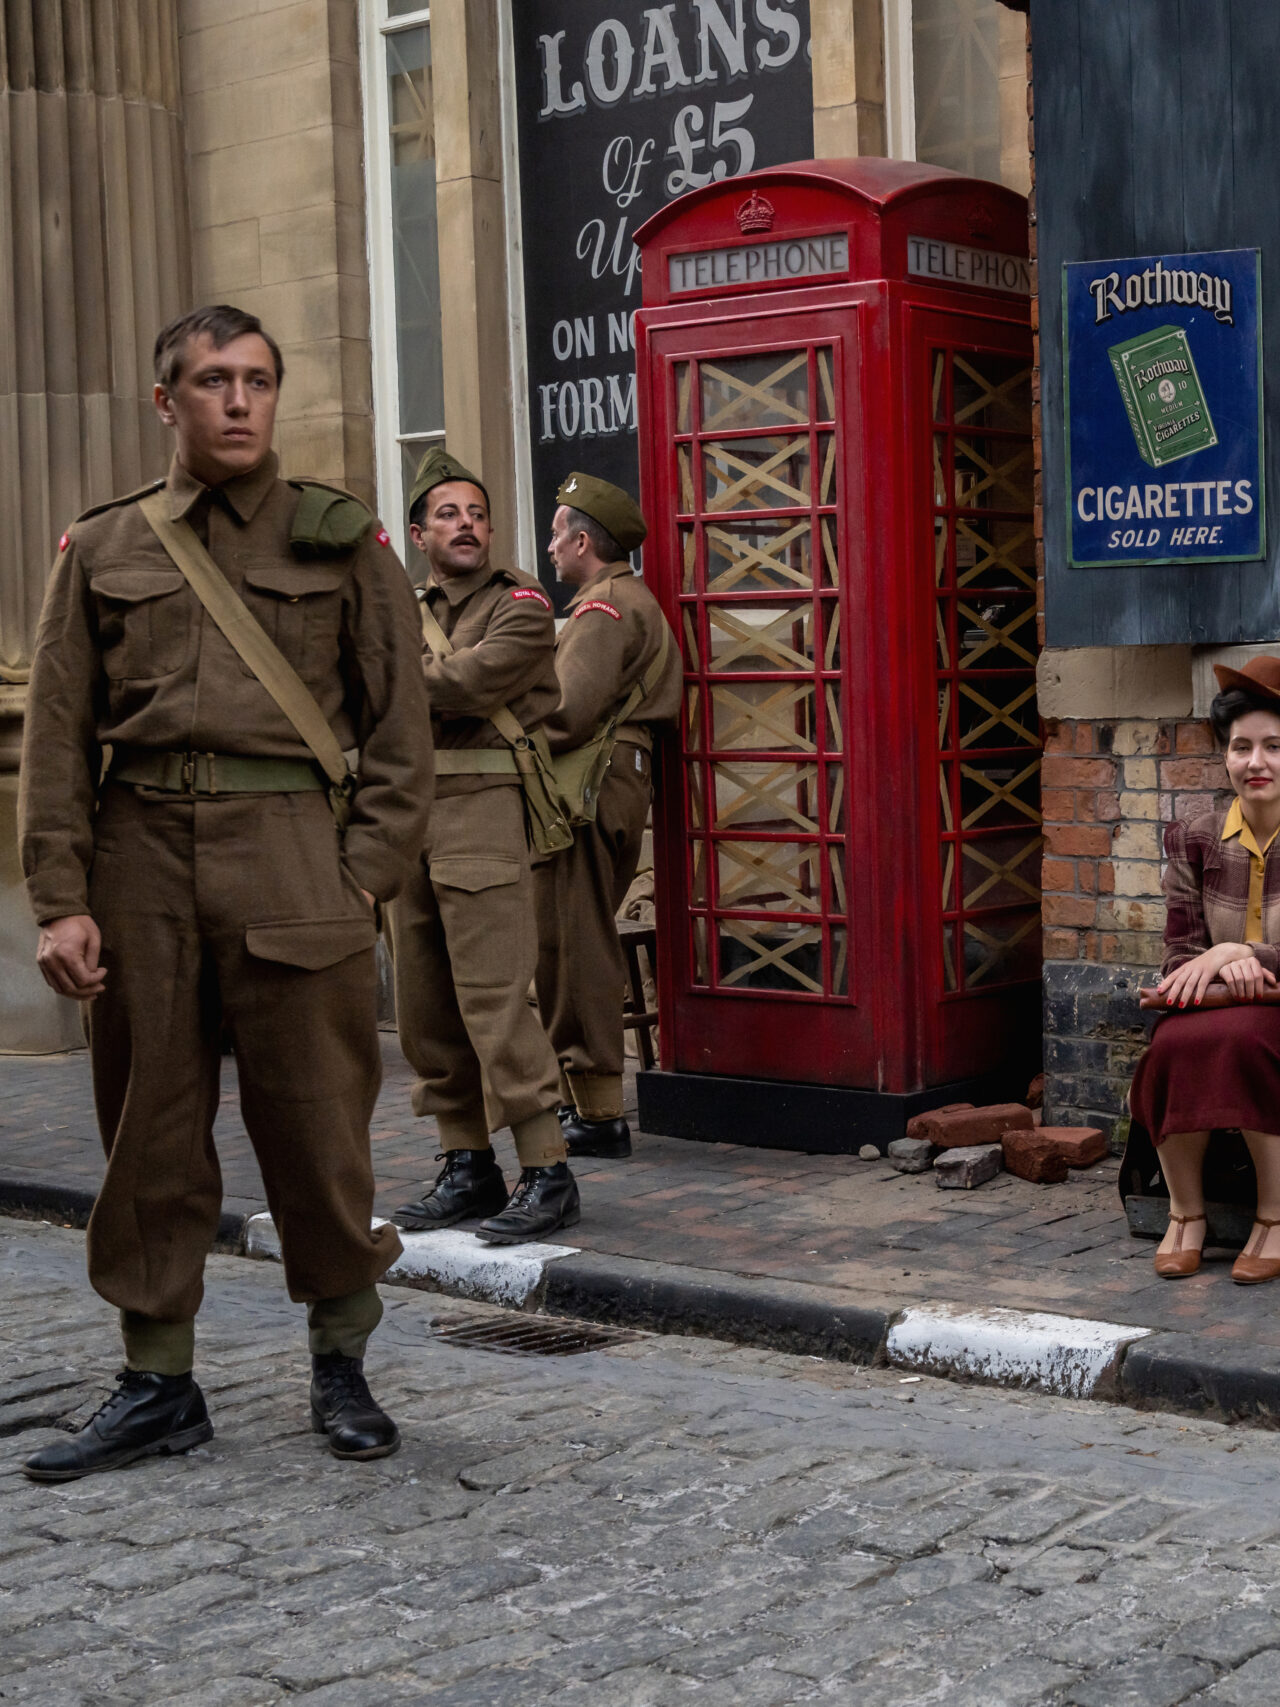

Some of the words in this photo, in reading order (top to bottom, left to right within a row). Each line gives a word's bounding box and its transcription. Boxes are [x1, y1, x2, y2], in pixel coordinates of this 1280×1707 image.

[602, 135, 655, 208] Of
[667, 93, 756, 194] £5
[675, 239, 845, 288] TELEPHONE
[1089, 261, 1234, 324] Rothway
[553, 316, 595, 361] ON
[1134, 359, 1191, 389] Rothway
[1147, 392, 1157, 403] 10
[1178, 380, 1187, 391] 10
[539, 373, 638, 440] FORM
[1155, 410, 1201, 442] CIGARETTES
[1078, 480, 1253, 522] CIGARETTES
[1108, 527, 1160, 549] SOLD
[1170, 526, 1224, 547] HERE.
